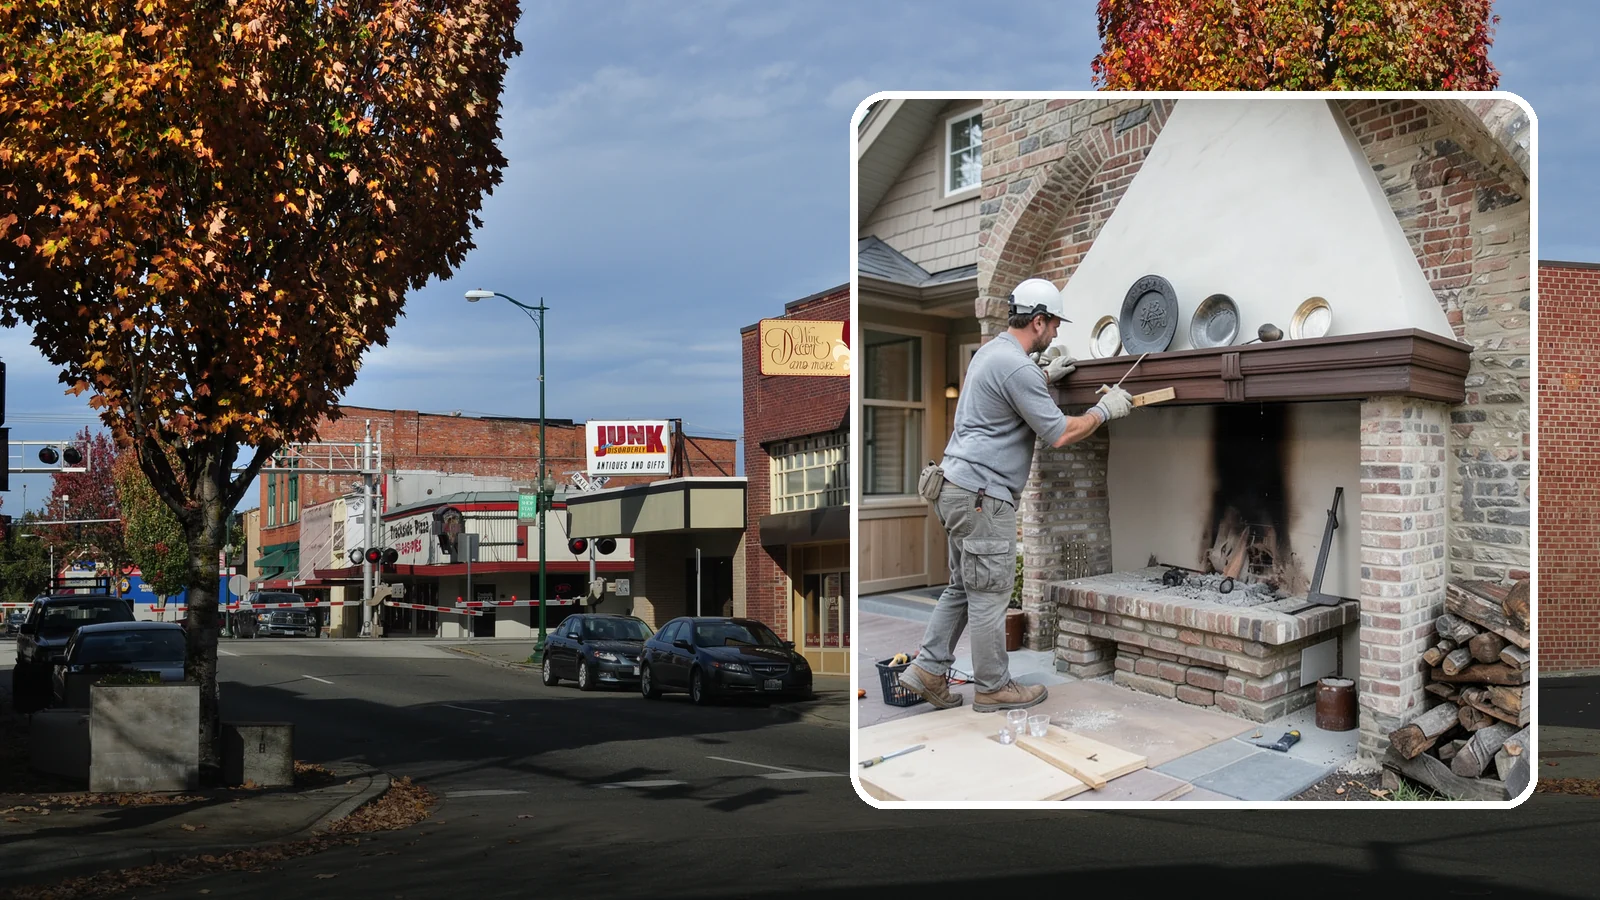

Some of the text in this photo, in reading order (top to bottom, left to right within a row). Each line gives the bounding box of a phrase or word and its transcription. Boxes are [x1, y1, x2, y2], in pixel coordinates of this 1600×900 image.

[596, 425, 665, 457] JUNK
[607, 446, 646, 454] DISORDERLY
[597, 460, 665, 470] ANTIQUES AND GIFTS
[390, 519, 429, 540] Trackside Pizza
